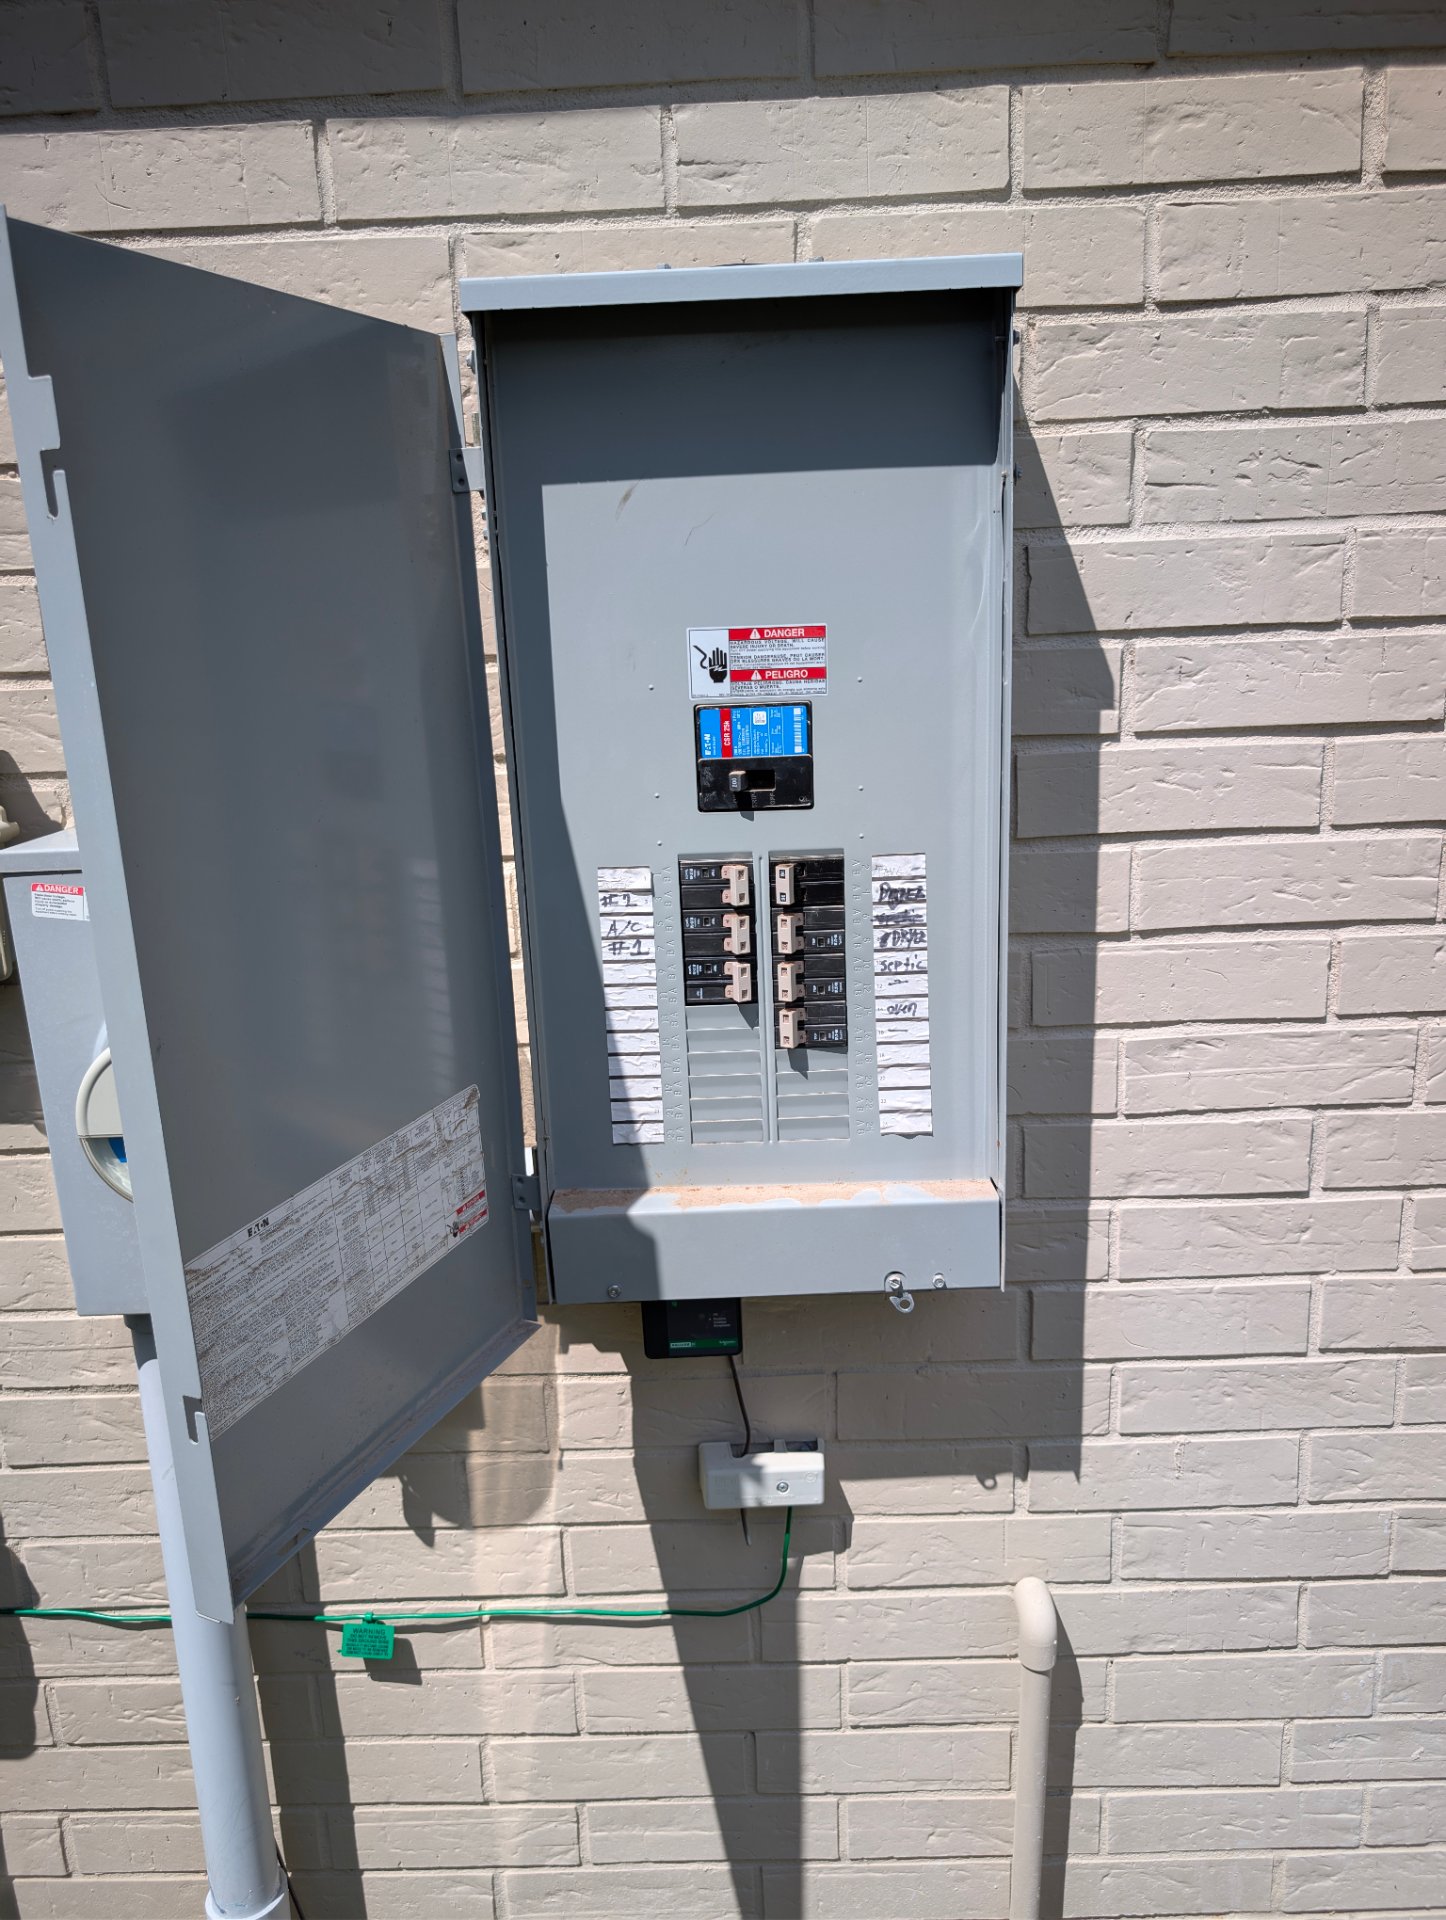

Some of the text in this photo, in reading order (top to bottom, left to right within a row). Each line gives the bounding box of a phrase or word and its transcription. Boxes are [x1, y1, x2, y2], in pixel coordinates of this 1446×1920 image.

[764, 628, 805, 638] DANGER
[765, 669, 808, 679] PELIGRO
[723, 733, 731, 747] CSR
[44, 884, 79, 894] DANGER
[606, 920, 642, 938] A/C
[606, 940, 650, 956] #1
[353, 1627, 385, 1635] WARNING
